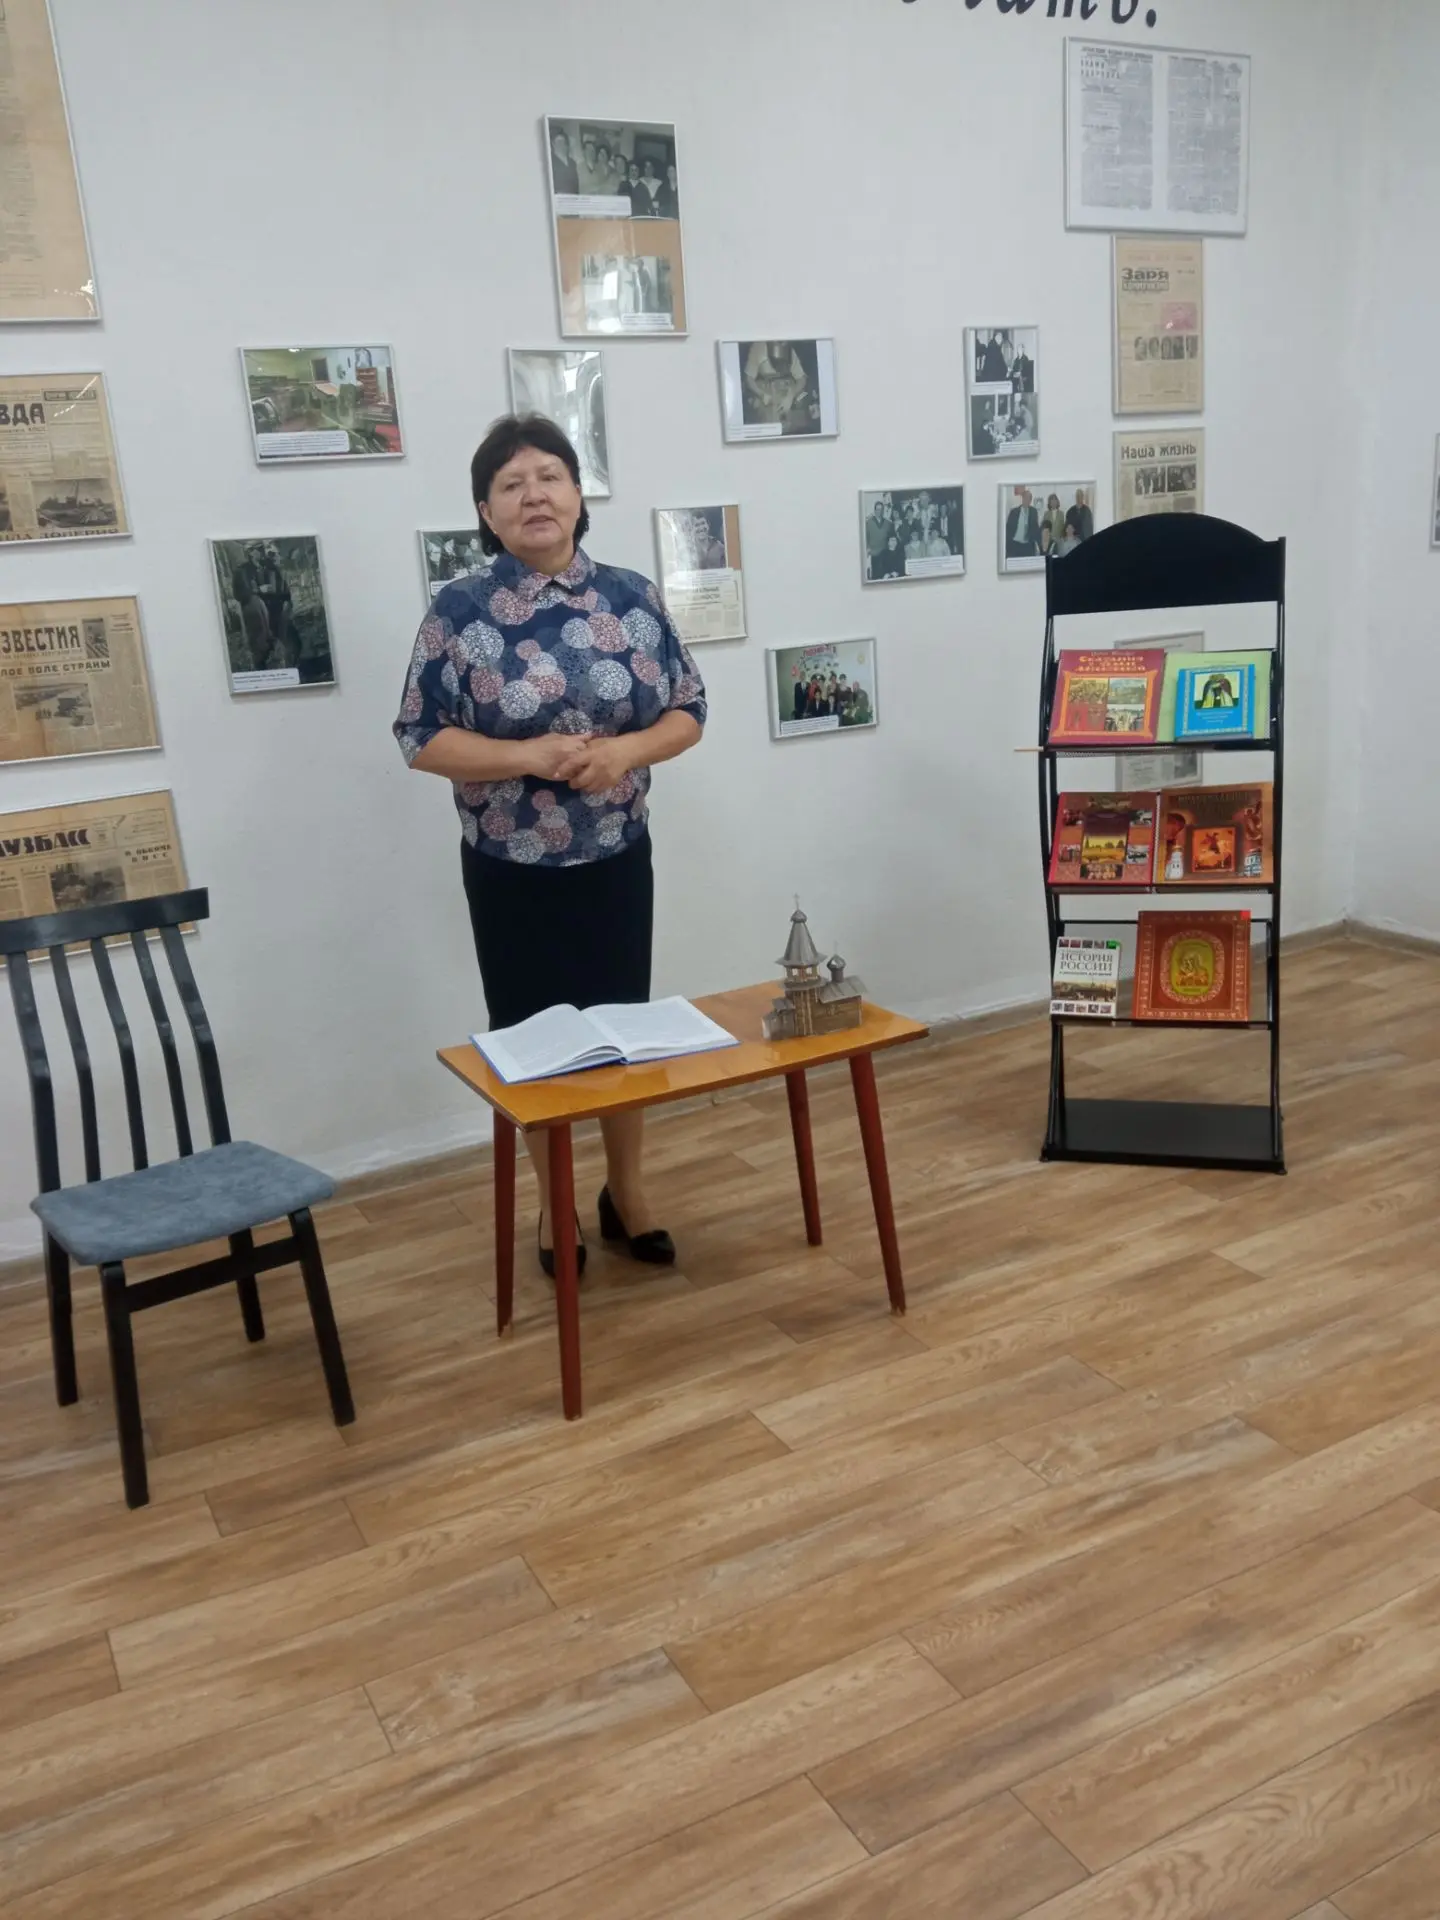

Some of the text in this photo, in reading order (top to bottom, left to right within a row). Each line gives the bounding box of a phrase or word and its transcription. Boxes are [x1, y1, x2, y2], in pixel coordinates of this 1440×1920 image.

[1121, 267, 1169, 281] Заря
[1121, 442, 1197, 459] Наша жизнь
[0, 625, 81, 654] ЗВЕСТИЯ
[62, 659, 111, 673] СТРАНЫ
[1060, 961, 1112, 971] РОССИИ
